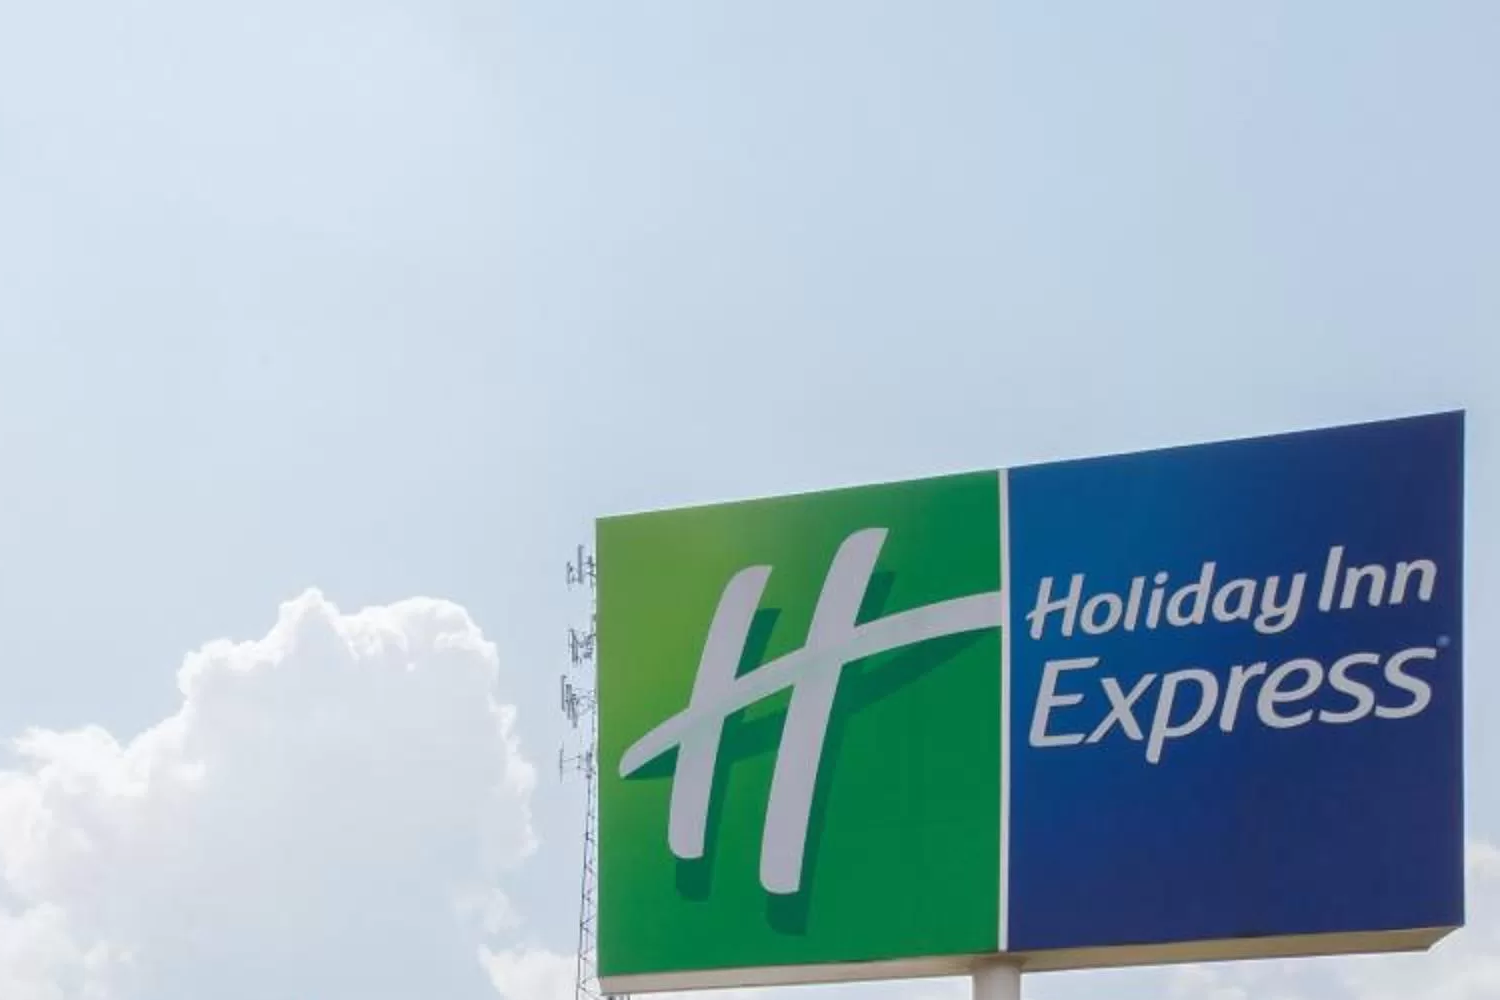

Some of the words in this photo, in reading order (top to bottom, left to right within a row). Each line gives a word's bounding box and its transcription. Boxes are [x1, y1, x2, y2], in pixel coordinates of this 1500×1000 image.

[1025, 561, 1307, 640] Holiday
[1318, 545, 1438, 612] Inn
[1028, 646, 1438, 765] Express
